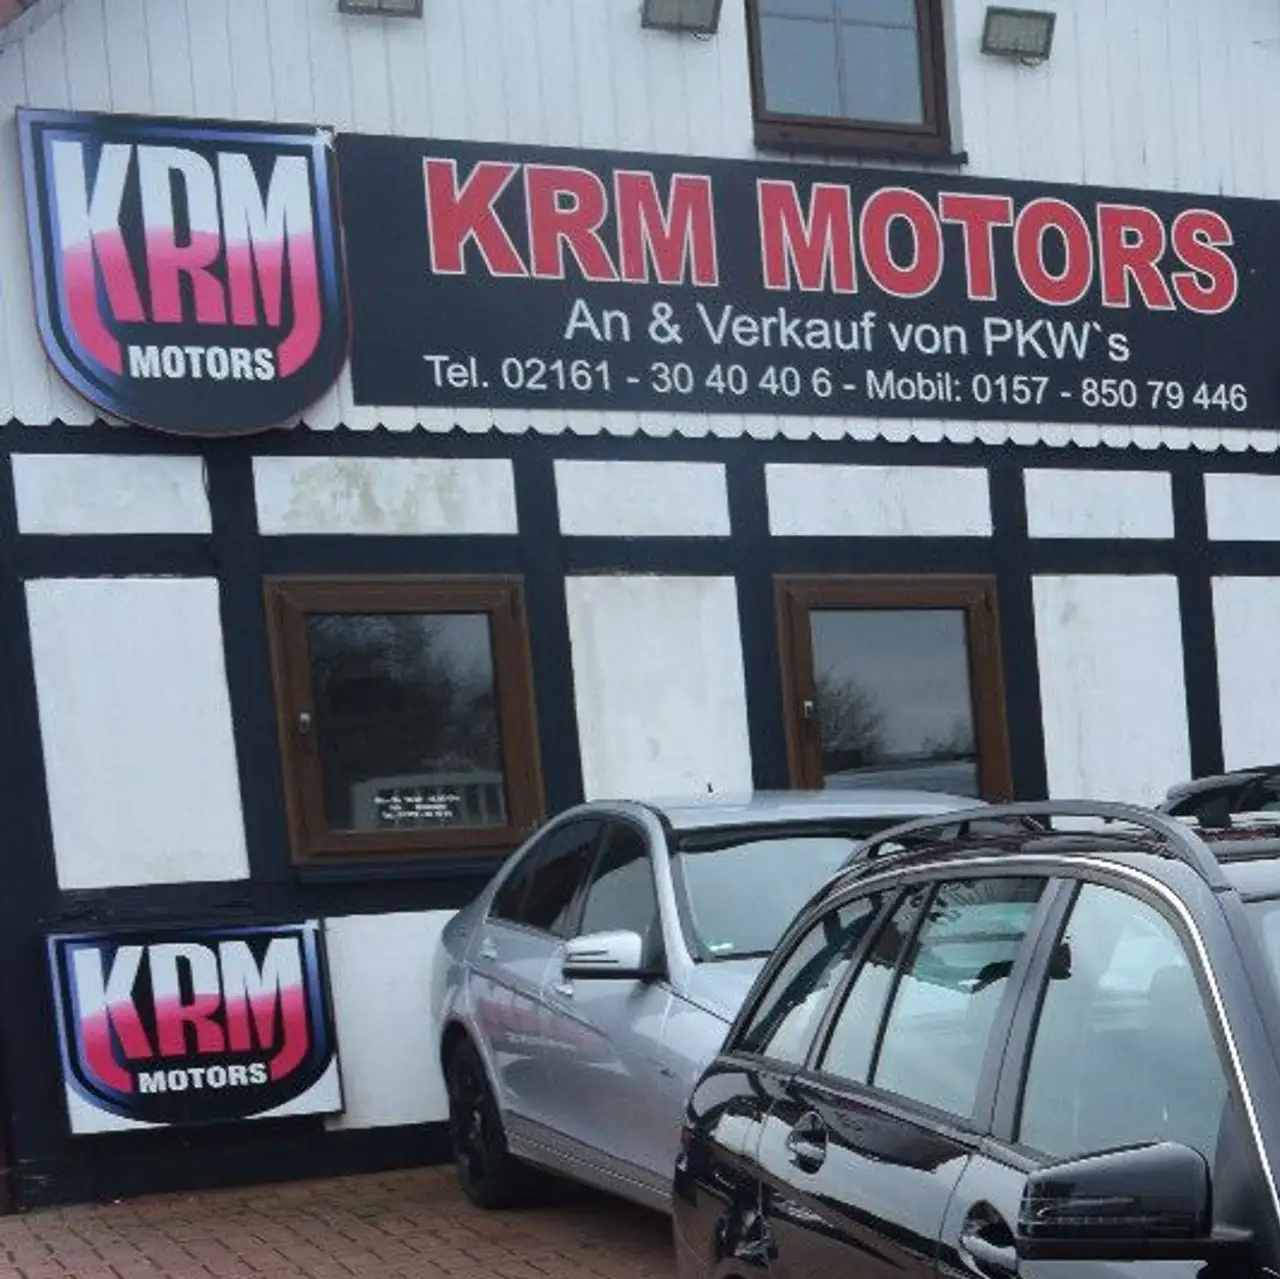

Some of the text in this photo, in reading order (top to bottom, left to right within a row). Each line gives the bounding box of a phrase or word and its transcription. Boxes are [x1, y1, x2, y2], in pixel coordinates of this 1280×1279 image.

[51, 139, 322, 376] KRM
[422, 155, 1238, 314] KRM MOTORS
[564, 299, 630, 343] An
[649, 304, 682, 344] &
[696, 302, 877, 351] Verkauf
[889, 324, 968, 356] von
[128, 345, 277, 382] MOTORS
[424, 355, 488, 389] Tel.
[502, 358, 611, 393] 02161
[651, 362, 694, 394] 30
[704, 363, 749, 395] 40
[758, 365, 802, 397] 40
[812, 367, 833, 398] 6
[866, 367, 961, 404] Mobil:
[971, 374, 1048, 406] 0157
[1080, 379, 1137, 409] 850
[1147, 381, 1184, 411] 79
[1192, 383, 1248, 412] 446
[73, 938, 309, 1093] KRM
[138, 1063, 268, 1093] MOTORS
